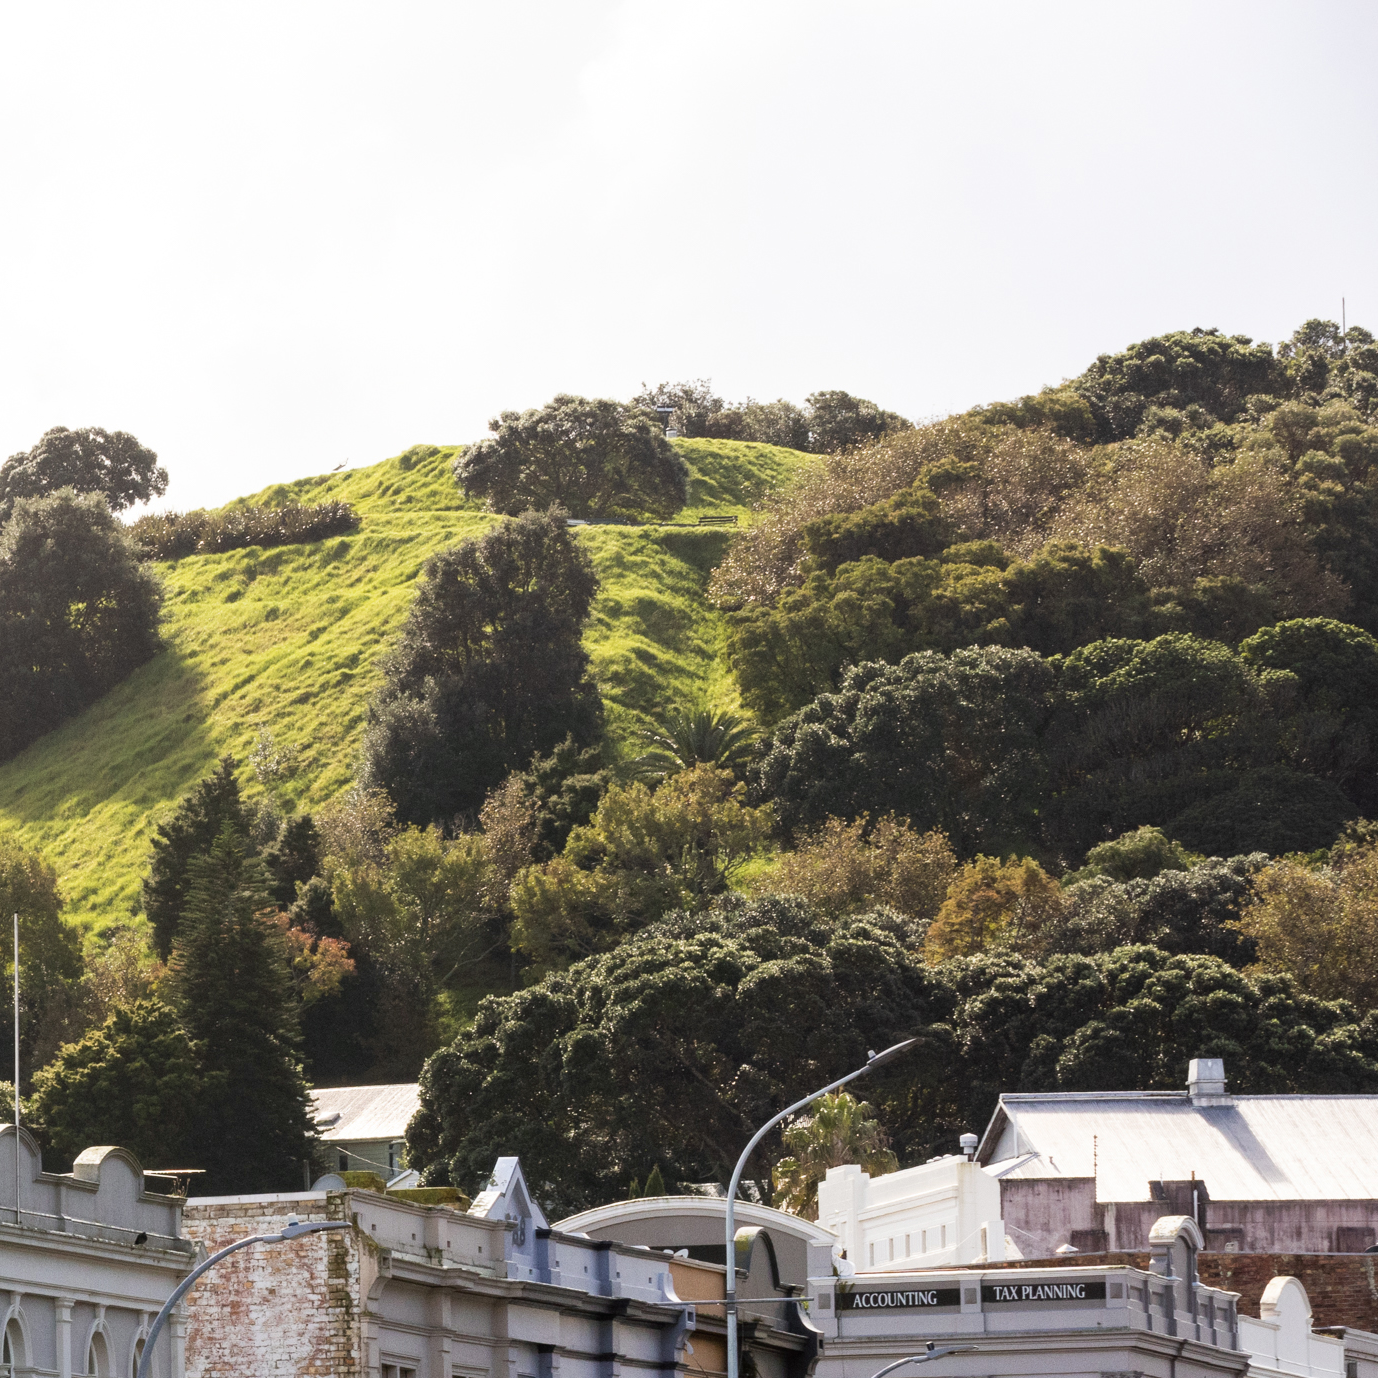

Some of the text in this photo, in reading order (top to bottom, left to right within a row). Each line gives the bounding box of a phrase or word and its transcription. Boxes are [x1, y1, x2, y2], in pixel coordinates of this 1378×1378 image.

[852, 1290, 937, 1308] ACCOUNTING
[993, 1283, 1086, 1301] TAX PLANNING
